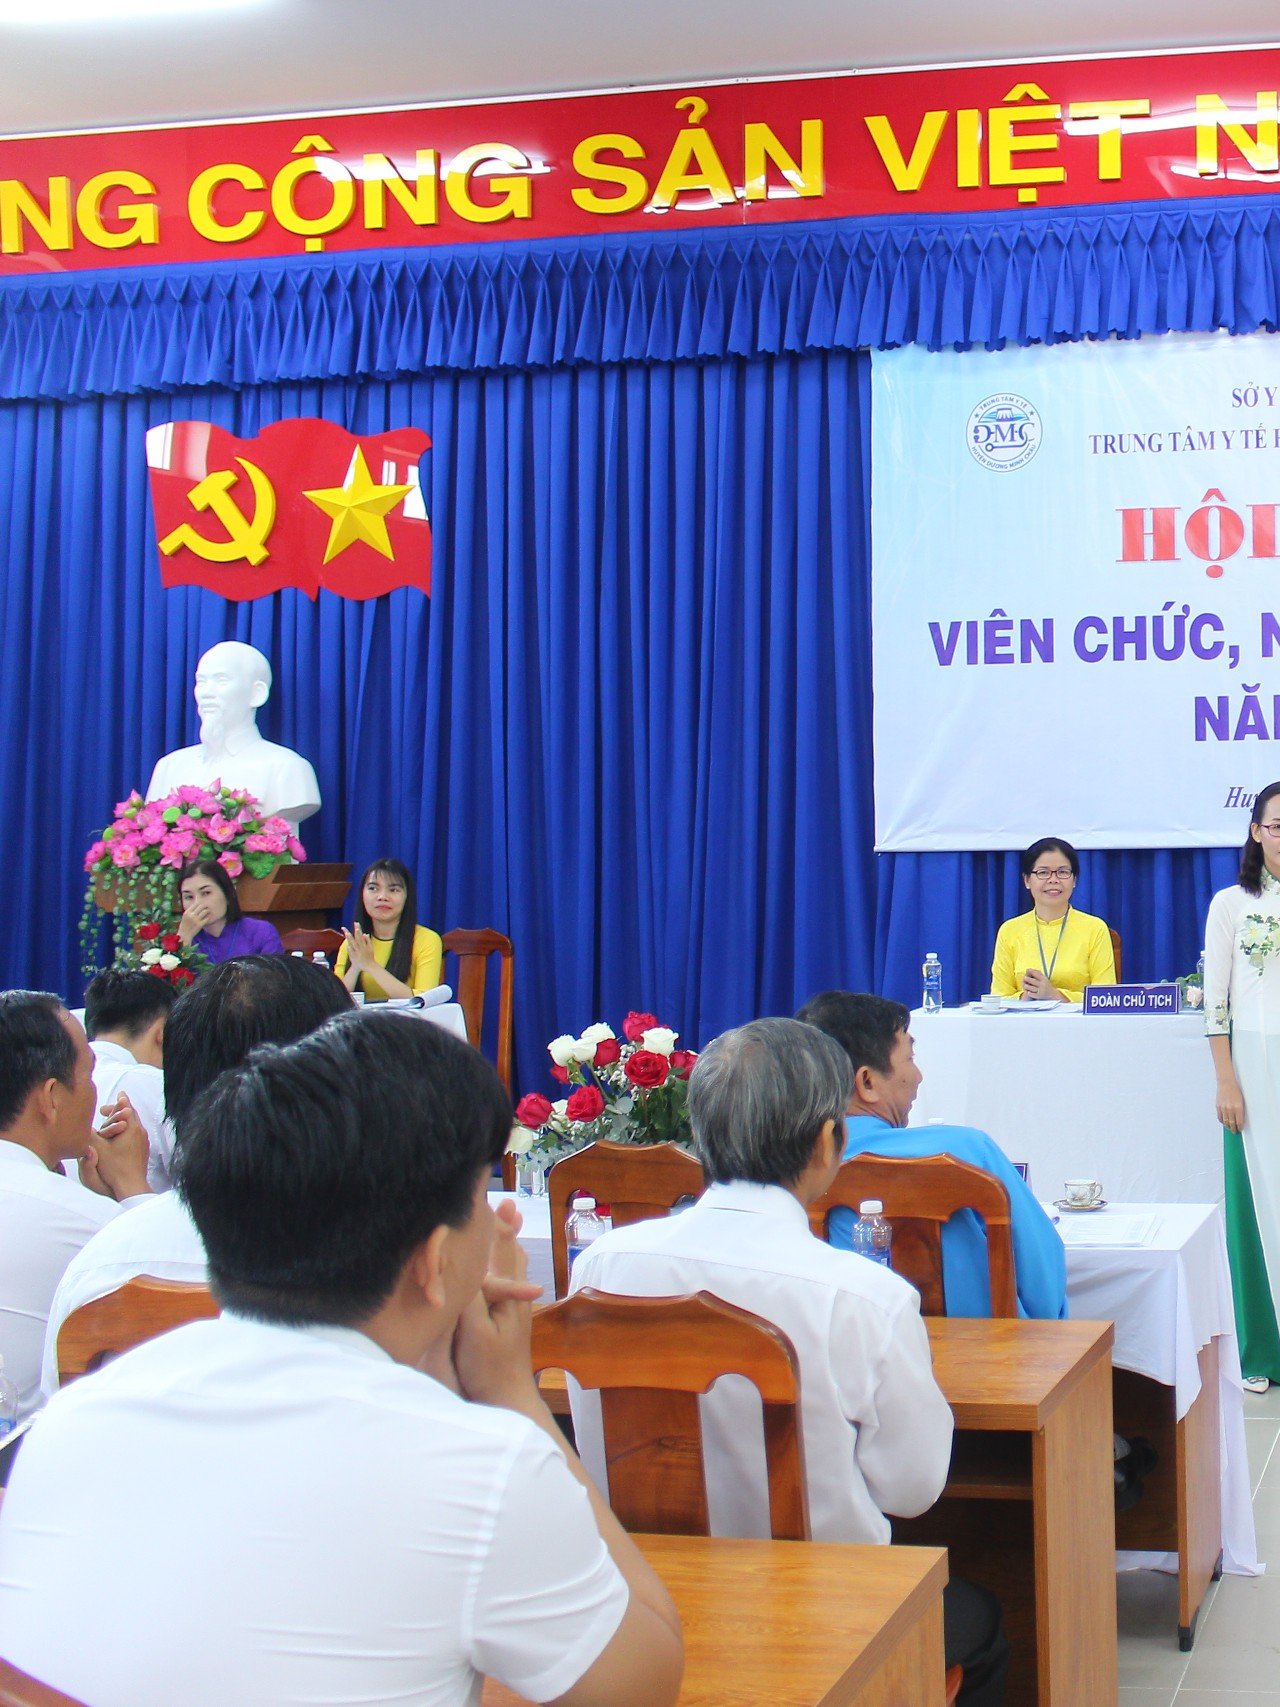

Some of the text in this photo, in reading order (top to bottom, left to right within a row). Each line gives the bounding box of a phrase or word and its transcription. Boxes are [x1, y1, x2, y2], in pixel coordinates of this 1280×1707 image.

[0, 170, 159, 254] NG
[187, 134, 533, 252] CỘNG
[570, 95, 824, 214] SẢN
[864, 83, 1151, 203] VIỆT
[1232, 382, 1260, 409] SỞ
[1264, 386, 1278, 407] Y
[1089, 432, 1163, 454] TRUNG
[1168, 425, 1216, 452] TÂM
[1221, 430, 1236, 450] Y
[1240, 422, 1267, 450] TẾ
[928, 608, 1054, 666] VIÊN
[1073, 601, 1240, 669] CHỨC,
[1091, 990, 1172, 1009] ĐOÀN CHỦ TỊCH
